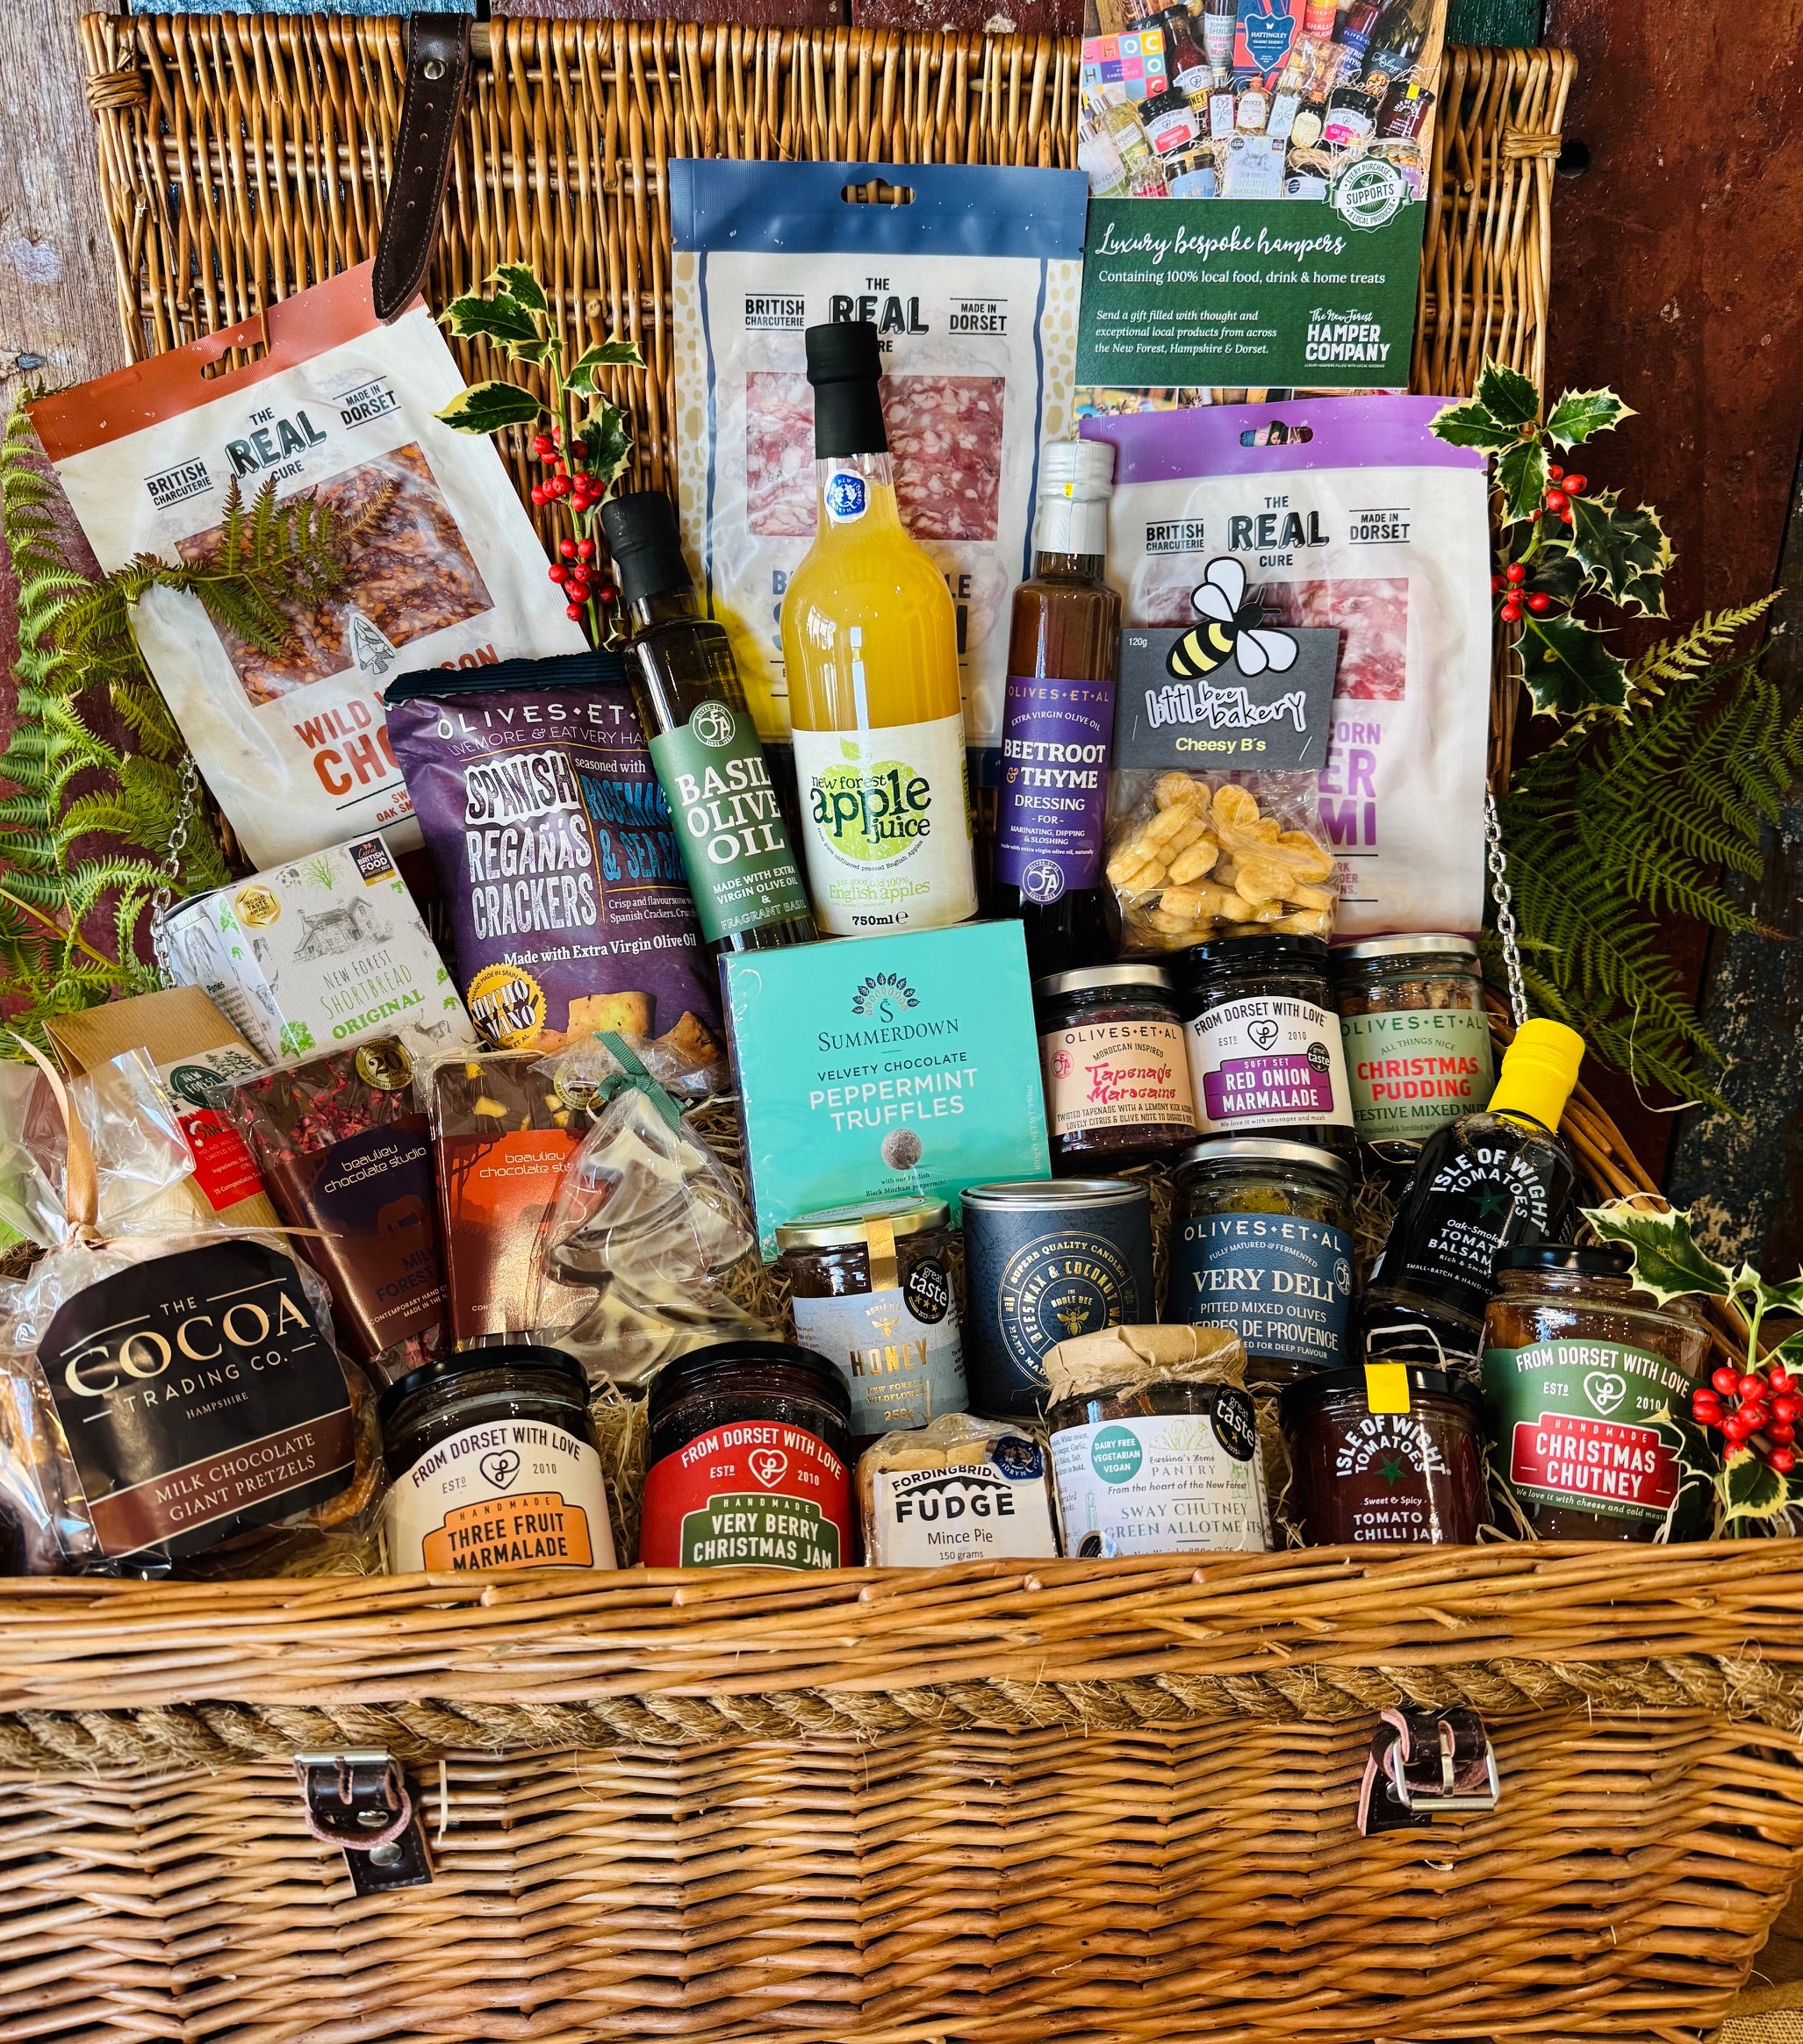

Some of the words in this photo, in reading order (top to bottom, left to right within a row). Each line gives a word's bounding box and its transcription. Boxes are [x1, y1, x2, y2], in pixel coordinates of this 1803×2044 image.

[1346, 169, 1361, 183] EVERY
[1361, 163, 1390, 176] PURCHASE
[1347, 183, 1394, 204] SUPPORTS
[1354, 213, 1368, 224] LOCAL
[1370, 204, 1395, 223] PRODUCER
[1095, 222, 1171, 264] Luxury
[1174, 226, 1255, 262] bespoke
[1257, 227, 1347, 262] hampers
[866, 278, 889, 290] THE
[1099, 270, 1163, 285] Containing
[1167, 271, 1198, 283] 100%
[1202, 271, 1229, 283] local
[1232, 271, 1262, 285] food,
[1266, 271, 1297, 283] drink
[1301, 273, 1310, 283] &
[1313, 272, 1347, 283] home
[1350, 273, 1385, 283] treats
[746, 299, 804, 315] BRITISH
[961, 304, 986, 312] MADE
[988, 304, 996, 312] IN
[1096, 311, 1119, 320] Send
[1131, 311, 1147, 322] gift
[1148, 311, 1173, 322] filled
[1176, 311, 1197, 320] with
[1200, 311, 1237, 323] thought
[1239, 311, 1258, 320] and
[745, 317, 804, 326] CHARCUTERIE
[950, 315, 1007, 331] DORSET
[1095, 326, 1150, 338] exceptional
[1152, 326, 1174, 337] local
[1176, 327, 1218, 339] products
[1219, 328, 1244, 340] from
[1307, 325, 1381, 341] HAMPER
[1095, 343, 1110, 353] the
[1112, 343, 1133, 353] New
[1136, 343, 1167, 355] Forest,
[1169, 343, 1222, 355] Hampshire
[1225, 344, 1232, 353] &
[1235, 344, 1268, 354] Dorset.
[1305, 343, 1390, 361] COMPANY
[346, 390, 368, 405] MADE
[370, 385, 381, 394] IN
[249, 407, 275, 426] THE
[341, 391, 397, 425] DORSET
[225, 411, 327, 479] REAL
[147, 463, 207, 496] BRITISH
[270, 461, 305, 483] CURE
[154, 477, 212, 506] CHARCUTERIE
[1264, 496, 1289, 508] THE
[1361, 513, 1387, 523] MADE
[1390, 513, 1398, 522] IN
[1146, 524, 1204, 541] BRITISH
[1228, 511, 1329, 551] REAL
[1350, 524, 1410, 540] DORSET
[1146, 540, 1204, 551] CHARCUTERIE
[1260, 555, 1293, 567] CURE
[1128, 637, 1147, 647] 120g
[1146, 685, 1210, 728] little
[1208, 691, 1305, 732] bakery
[294, 699, 371, 749] WILD
[1005, 739, 1105, 764] BEETROOT
[1175, 738, 1237, 754] Cheesy
[575, 757, 617, 773] seasoned
[620, 760, 646, 773] with
[468, 756, 577, 821] SPANISH
[675, 757, 772, 807] BASIL
[812, 777, 837, 788] new
[839, 776, 887, 789] forest
[1007, 767, 1018, 784] &
[1021, 767, 1098, 789] THYME
[810, 770, 931, 837] apple
[1015, 795, 1085, 810] DRESSING
[687, 791, 780, 838] OLIVE
[867, 816, 930, 843] juice
[707, 824, 786, 864] OIL
[471, 872, 597, 939] CRACKERS
[354, 950, 392, 977] FOREST
[320, 965, 413, 1020] SHORTBREAD
[333, 989, 426, 1039] ORIGINAL
[818, 1019, 959, 1052] SUMMERDOWN
[1093, 1044, 1132, 1061] MOROCCAN
[1135, 1044, 1164, 1058] INSPIRED
[817, 1064, 879, 1082] VELVETY
[884, 1052, 967, 1072] CHOCOLATE
[1085, 1063, 1171, 1087] Tapenade
[1357, 1057, 1478, 1080] CHRISTMAS
[809, 1068, 979, 1110] PEPPERMINT
[1225, 1073, 1255, 1091] RED
[1262, 1068, 1311, 1087] ONION
[1372, 1079, 1471, 1101] PUDDING
[1087, 1086, 1176, 1104] Marocaine
[1223, 1090, 1318, 1112] MARMALADE
[830, 1095, 965, 1132] TRUFFLES
[341, 1144, 399, 1172] beaulieu
[324, 1161, 389, 1194] chocolate
[391, 1146, 427, 1168] studio
[1430, 1154, 1472, 1192] ISLE
[1477, 1148, 1506, 1164] OF
[1511, 1157, 1548, 1233] WIGHT
[1451, 1168, 1528, 1219] TOMATOES
[910, 1273, 947, 1306] taste
[1193, 1268, 1265, 1293] VERY
[1272, 1271, 1335, 1303] DELI
[161, 1296, 198, 1316] THE
[1201, 1302, 1239, 1314] PITTED
[1241, 1304, 1283, 1315] MIXED
[1287, 1305, 1326, 1323] OLIVES
[65, 1290, 311, 1397] COCOA
[850, 1338, 927, 1377] HONEY
[124, 1363, 241, 1413] TRADING
[251, 1351, 288, 1371] CO.
[1516, 1348, 1554, 1373] FROM
[1558, 1347, 1619, 1369] DORSET
[1624, 1353, 1659, 1381] WITH
[1661, 1366, 1690, 1399] LOVE
[186, 1392, 248, 1419] HAMPSHIRE
[1094, 1451, 1140, 1462] VEGETARIAN
[1095, 1440, 1116, 1451] DAIRY
[1355, 1436, 1425, 1474] TOMATOES
[1536, 1432, 1656, 1474] CHRISTMAS
[154, 1474, 205, 1504] MILK
[210, 1433, 315, 1482] CHOCOLATE
[1103, 1464, 1131, 1473] VEGAN
[1547, 1461, 1643, 1498] CHUTNEY
[169, 1488, 229, 1522] GIANT
[236, 1455, 317, 1495] PRETZELS
[896, 1494, 1015, 1523] FUDGE
[1122, 1505, 1167, 1519] SWAY
[1174, 1503, 1248, 1516] CHUTNEY
[1401, 1496, 1422, 1505] Spicy
[1517, 1488, 1527, 1496] We
[1528, 1490, 1545, 1500] love
[1547, 1492, 1554, 1501] it
[1555, 1495, 1574, 1505] with
[1577, 1497, 1605, 1510] cheese
[1608, 1503, 1625, 1513] and
[1627, 1507, 1643, 1517] cold
[712, 1513, 758, 1534] VERY
[765, 1514, 819, 1542] BERRY
[1354, 1512, 1423, 1525] TOMATO
[448, 1519, 506, 1551] THREE
[514, 1513, 564, 1535] FRUIT
[928, 1531, 970, 1545] Mince
[974, 1529, 993, 1542] Pie
[1354, 1528, 1407, 1541] CHILLI
[1413, 1529, 1443, 1541] JAM
[453, 1537, 568, 1570] MARMALADE
[693, 1537, 797, 1562] CHRISTMAS
[802, 1545, 831, 1568] JAM
[958, 1551, 983, 1560] grams
